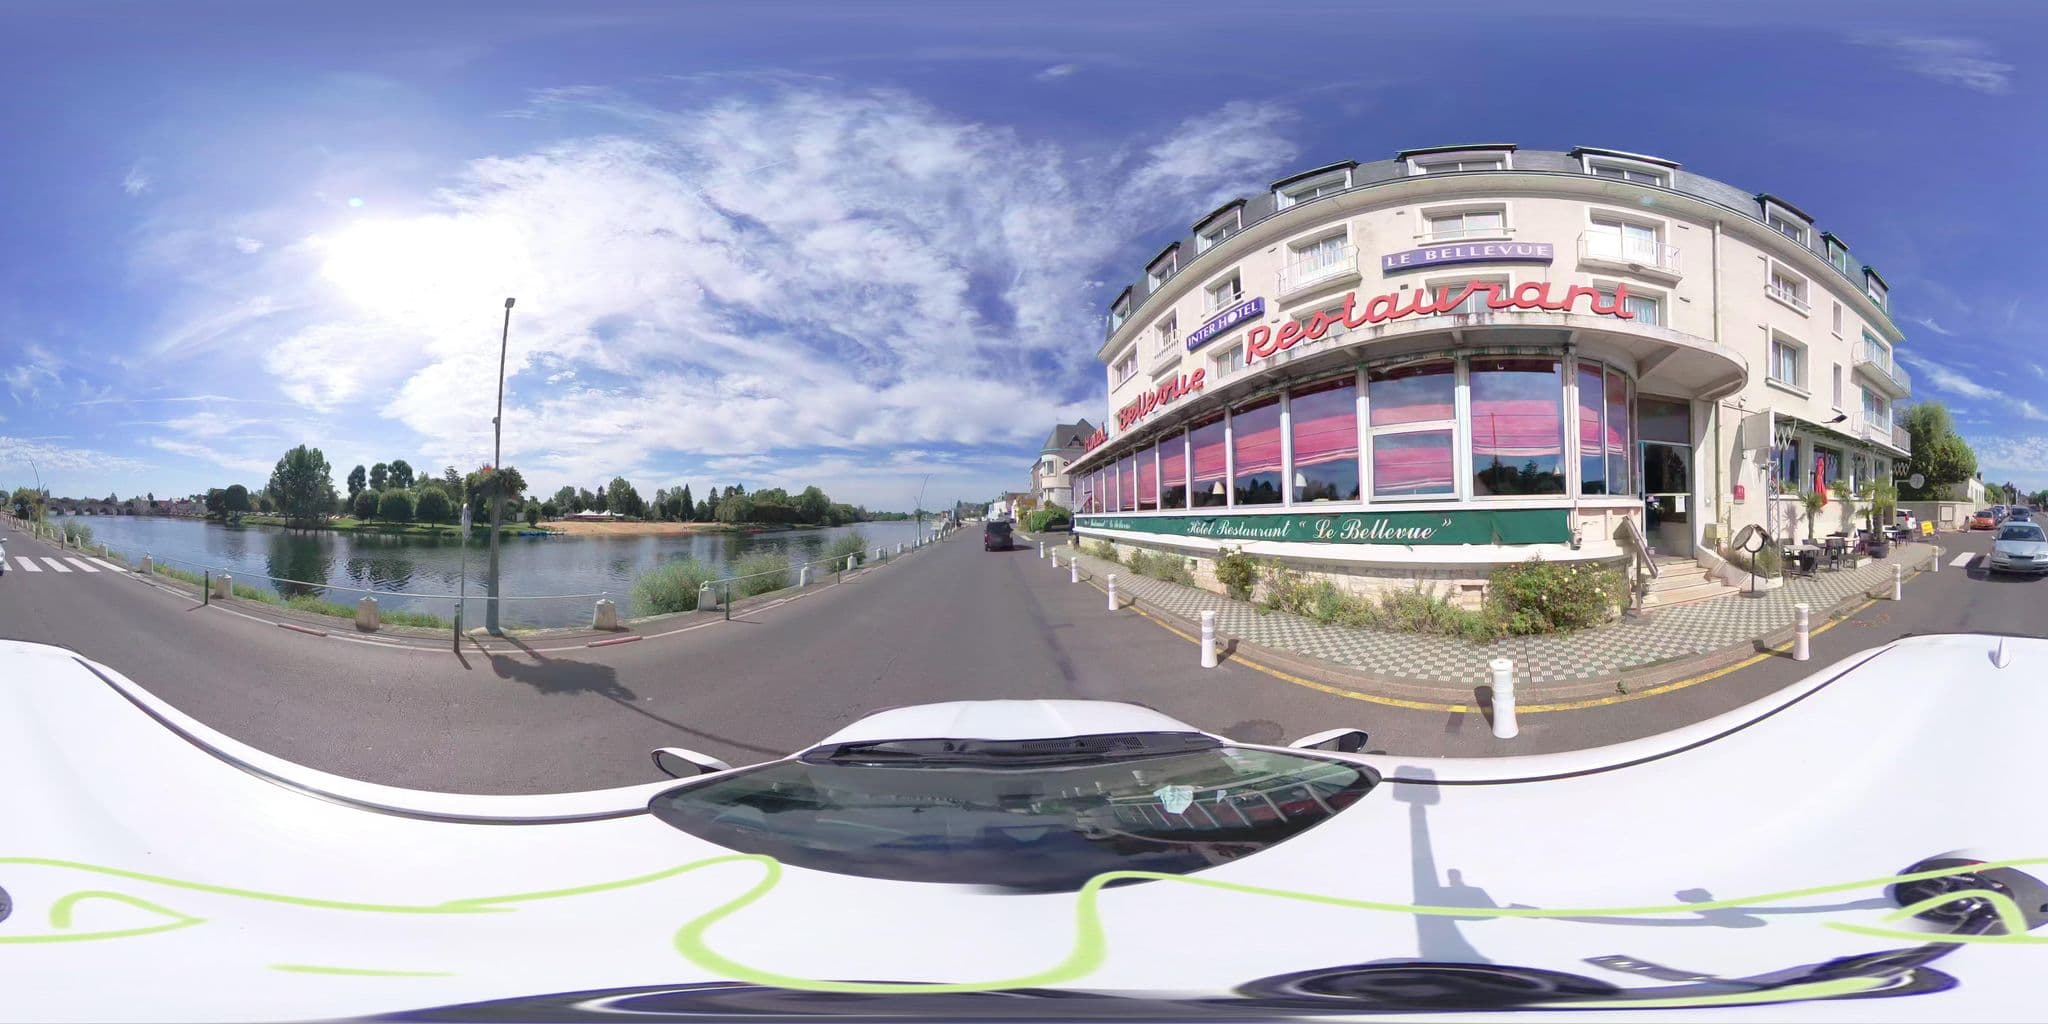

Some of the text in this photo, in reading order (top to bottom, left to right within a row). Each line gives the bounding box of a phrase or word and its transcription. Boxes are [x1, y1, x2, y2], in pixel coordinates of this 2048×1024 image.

[1387, 245, 1550, 267] LE BELLEVUE
[1188, 301, 1258, 346] INTER HOTEL
[1118, 367, 1206, 431] Bellevue
[1246, 279, 1635, 364] Restaurant
[1216, 520, 1290, 537] Restaurant
[1313, 518, 1336, 539] Le
[1339, 518, 1437, 540] Bellevue
